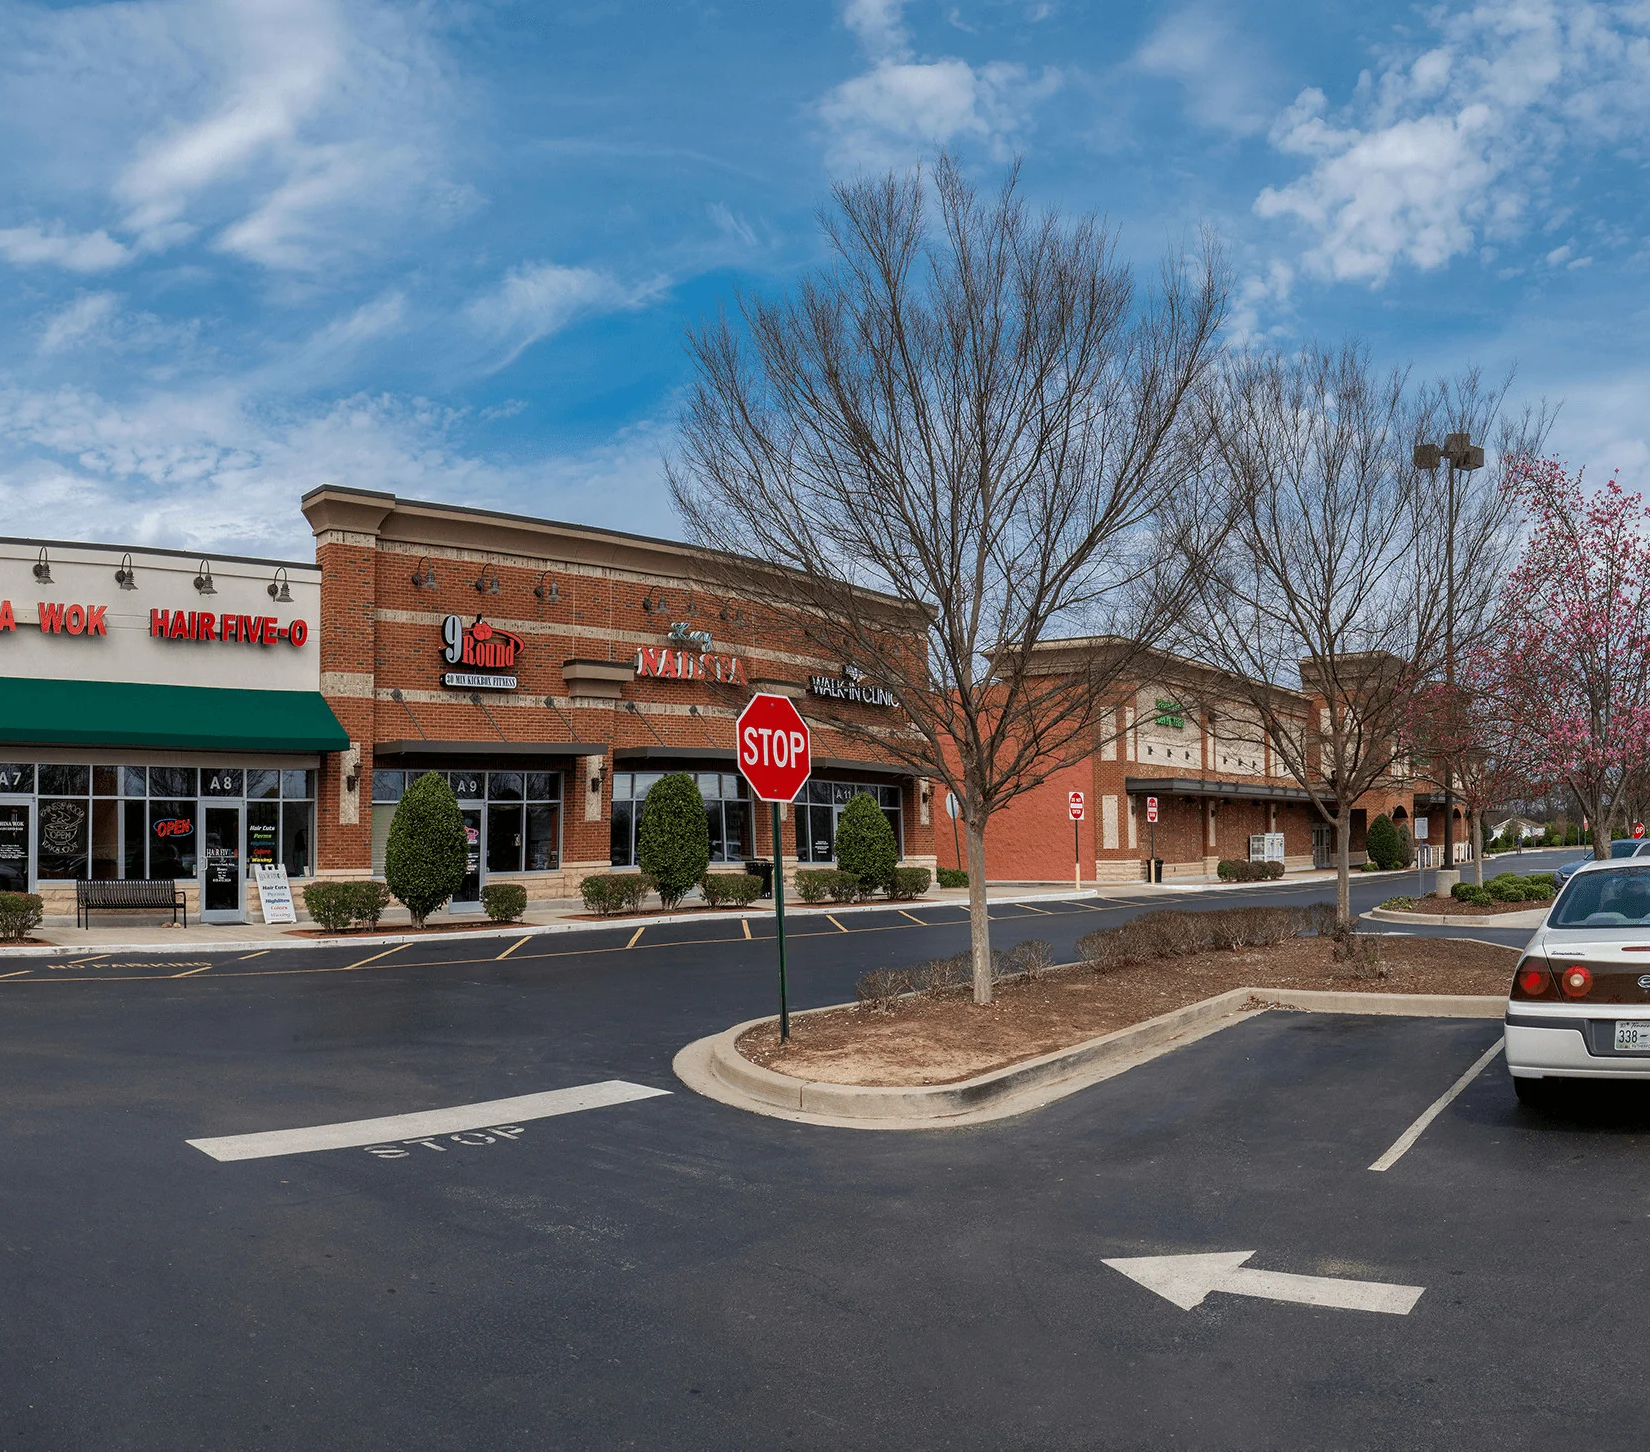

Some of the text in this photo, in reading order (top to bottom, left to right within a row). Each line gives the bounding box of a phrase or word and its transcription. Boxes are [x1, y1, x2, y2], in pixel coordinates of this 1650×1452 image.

[38, 601, 108, 635] WOK
[150, 608, 309, 647] HAIR FIVE-O
[455, 674, 466, 685] MIN
[467, 675, 491, 686] KICKBOX
[492, 677, 516, 687] FITNESS
[637, 647, 748, 685] NAIL SPA
[811, 675, 900, 707] WALK-IN CLINIC
[743, 726, 805, 769] STOP
[157, 818, 191, 837] OPEN
[91, 961, 212, 969] PARKING
[1618, 1029, 1638, 1043] 338
[363, 1125, 525, 1159] STOP
